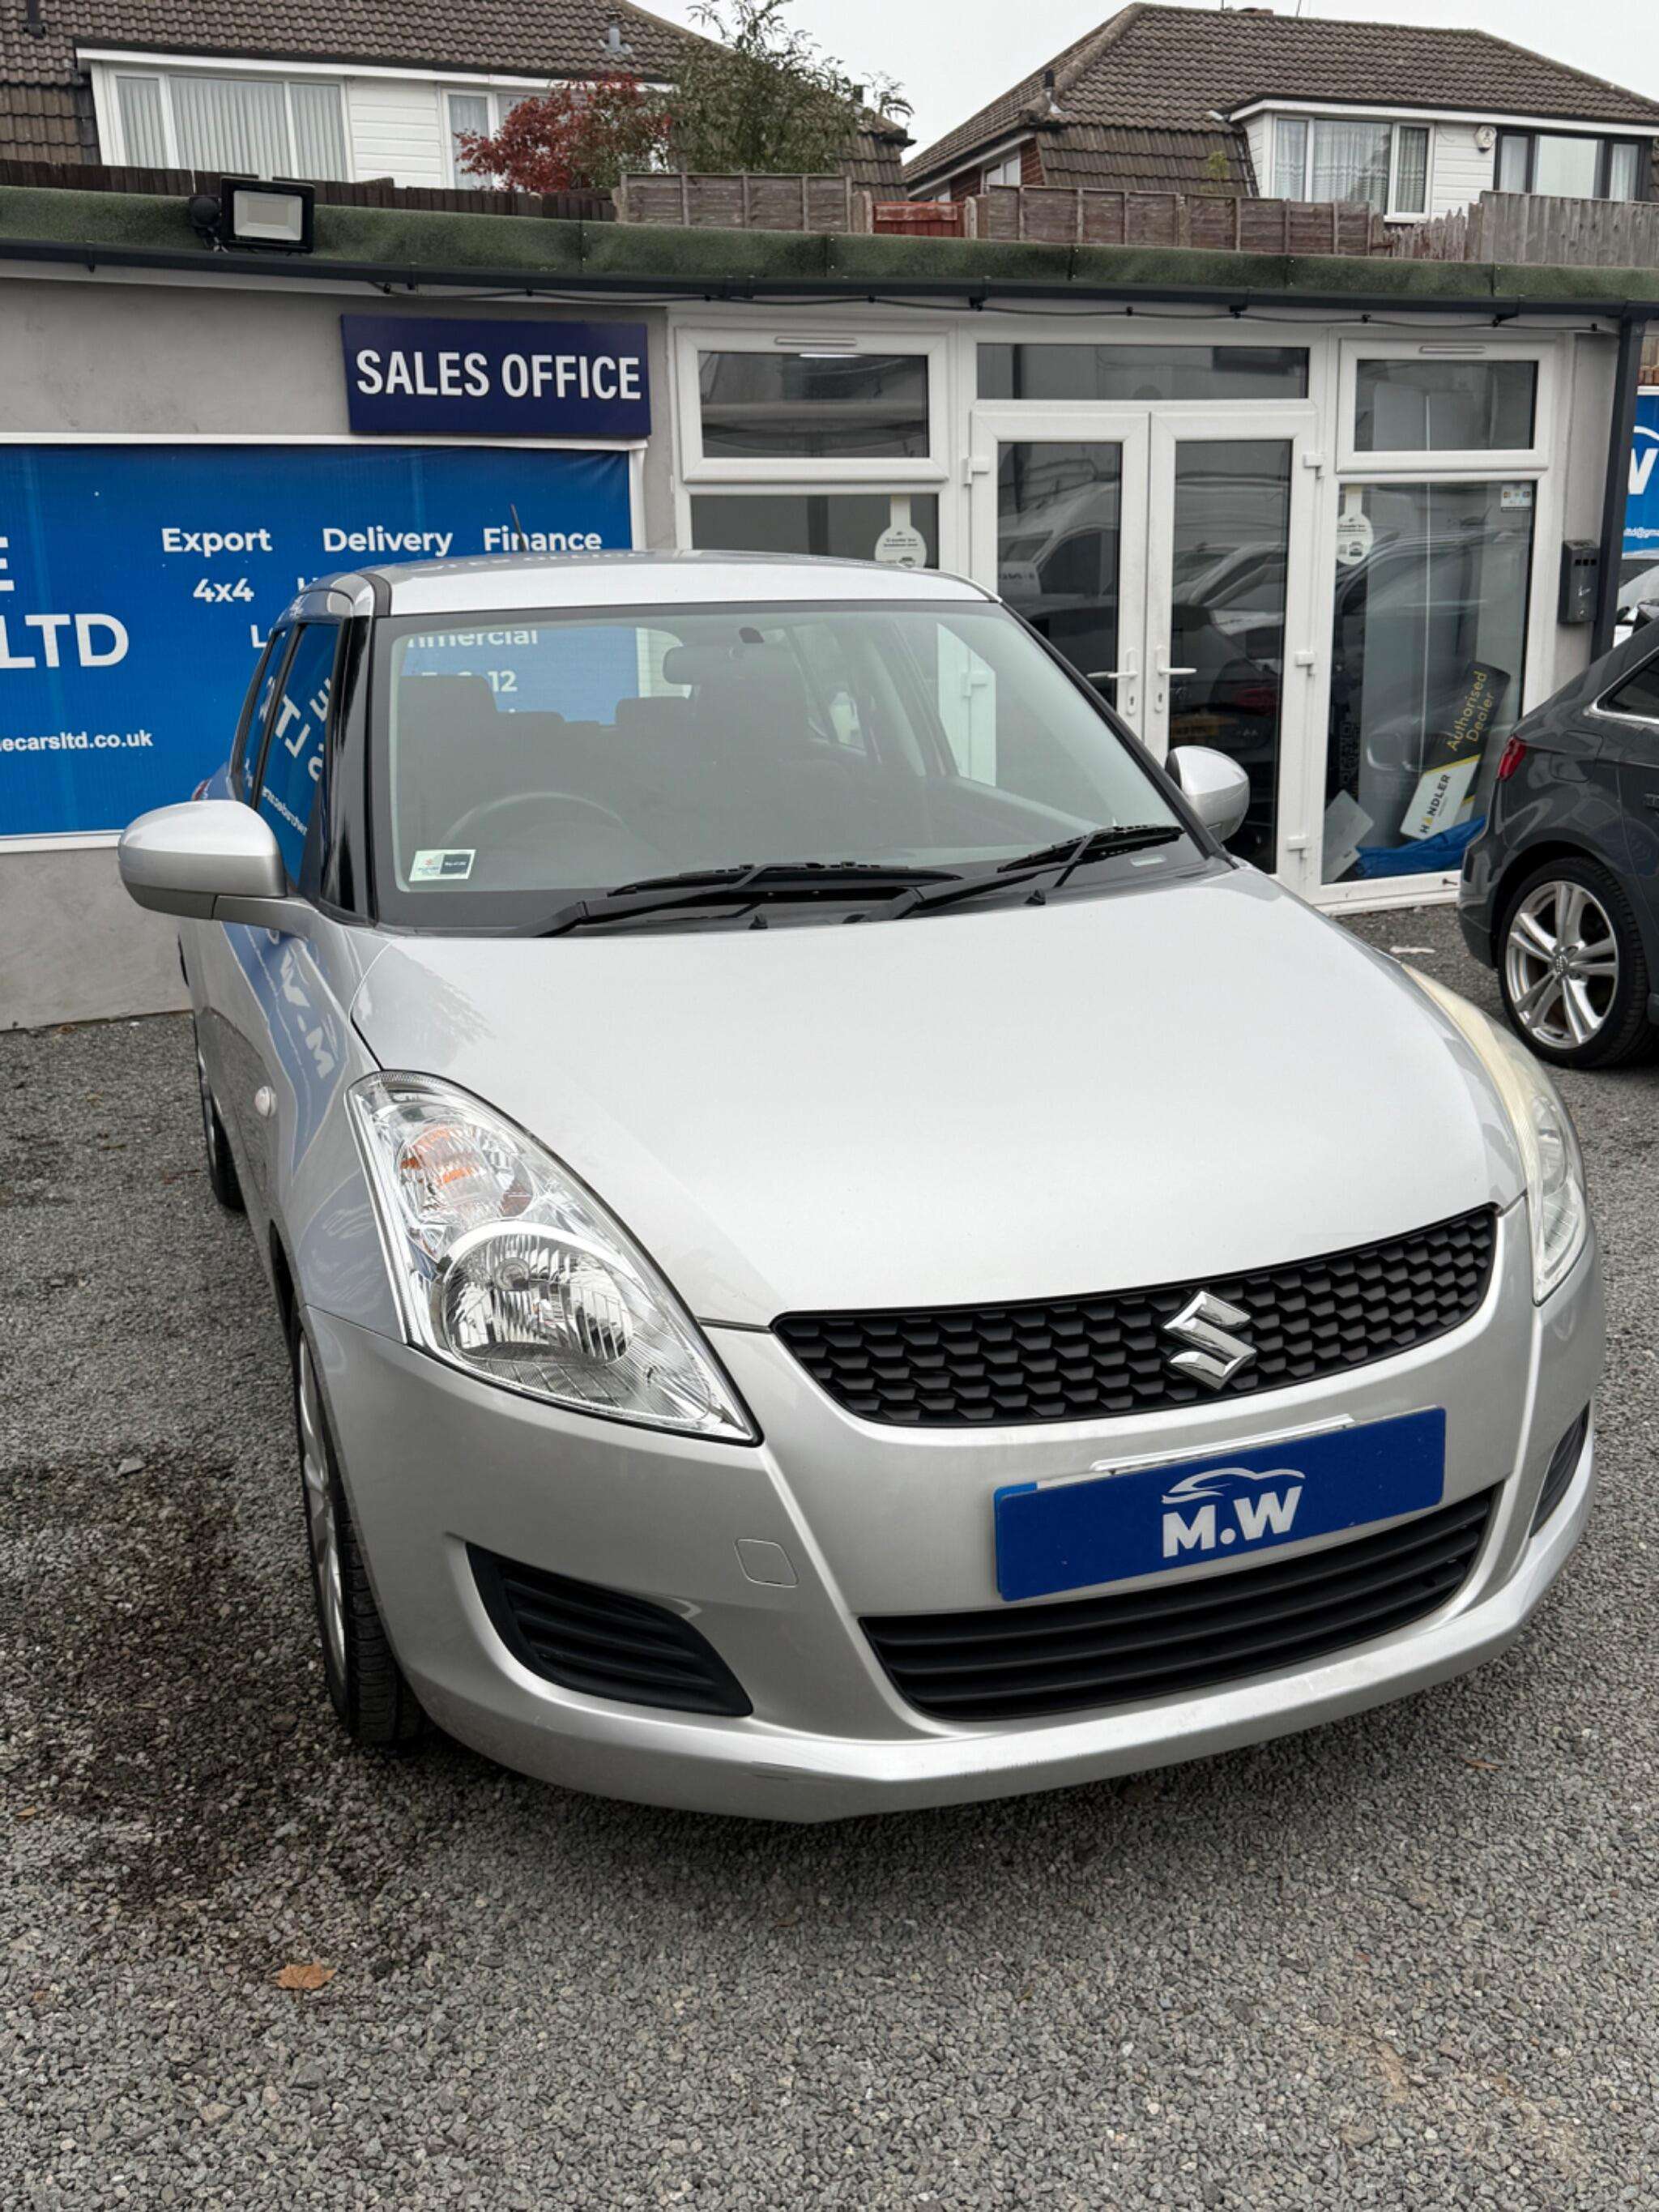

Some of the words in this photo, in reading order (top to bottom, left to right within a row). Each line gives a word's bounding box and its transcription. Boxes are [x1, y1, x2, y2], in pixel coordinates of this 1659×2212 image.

[356, 349, 489, 397] SALES
[501, 353, 642, 399] OFFICE
[161, 527, 273, 557] Export
[322, 525, 453, 557] Delivery
[483, 525, 602, 553] Finance
[193, 578, 254, 603] 4x4
[0, 613, 130, 669] LTD
[487, 670, 518, 692] 12
[1446, 670, 1487, 752] Authorised
[1465, 692, 1495, 743] Dealer
[0, 729, 154, 752] ecarsltd.co.uk
[1162, 1485, 1303, 1558] M.W
